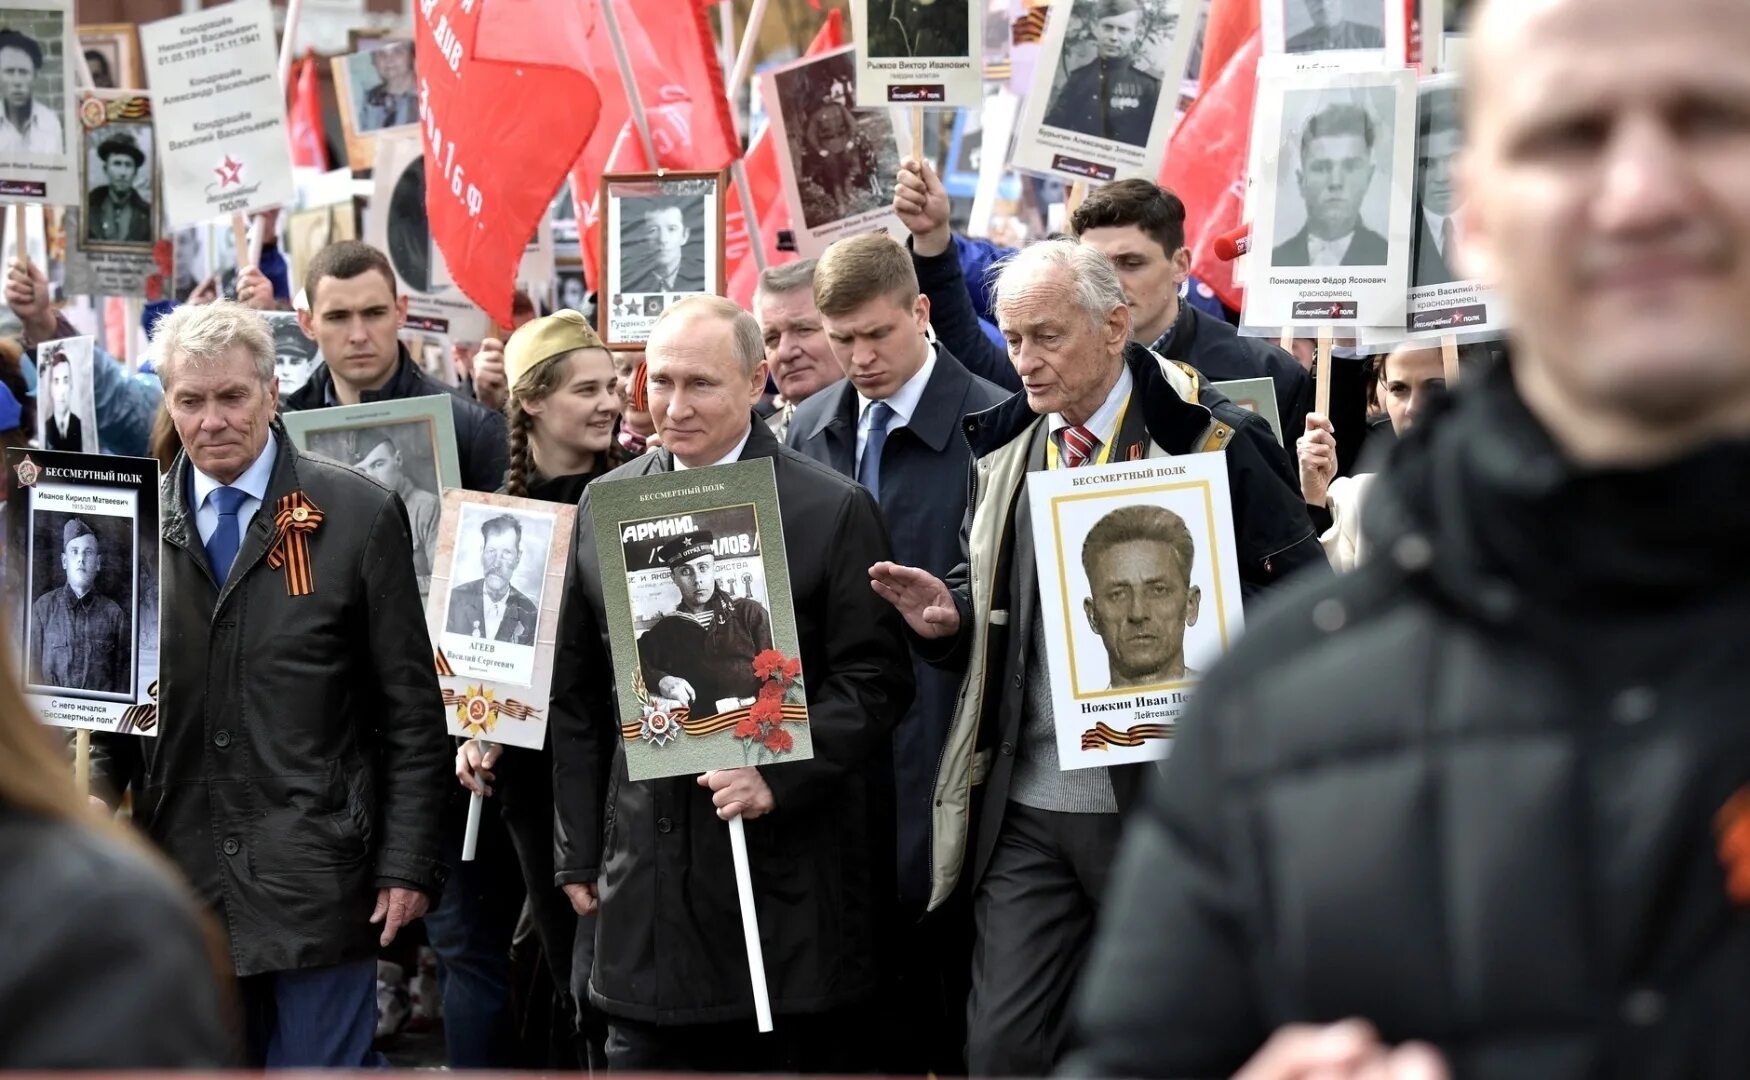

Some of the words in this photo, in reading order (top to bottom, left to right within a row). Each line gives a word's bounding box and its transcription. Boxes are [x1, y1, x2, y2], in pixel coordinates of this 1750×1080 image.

[899, 61, 928, 70] Виктор
[929, 60, 970, 69] Иванович
[1270, 277, 1320, 285] Пономаренко
[1322, 276, 1346, 285] Фёдор
[1348, 276, 1386, 284] Ясонович
[1299, 289, 1352, 297] красноармеец
[1438, 284, 1474, 296] Василий
[1417, 296, 1478, 309] красноармеец
[45, 467, 116, 481] БЕССМЕРТНЫЙ
[117, 473, 143, 484] ПОЛК
[1072, 468, 1154, 486] БЕССМЕРТНЫЙ
[1157, 466, 1187, 477] ПОЛК
[38, 491, 64, 501] Иванов
[65, 493, 91, 503] Кирилл
[92, 496, 129, 506] Матвеевич
[639, 486, 701, 502] БЕССМЕРТНЫЙ
[702, 482, 725, 492] ПОЛК
[622, 515, 699, 543] АРМИЮ.
[469, 642, 495, 653] АГЕЕВ
[447, 650, 476, 663] Василий
[477, 655, 515, 670] Сергеевич
[51, 700, 58, 708] С
[58, 703, 76, 711] него
[77, 705, 107, 714] начался
[1081, 701, 1132, 714] Ножкин
[1135, 695, 1168, 708] Иван
[41, 709, 95, 723] "Бессмертный
[96, 716, 118, 725] полк"
[1134, 709, 1180, 720] Лейтенант
